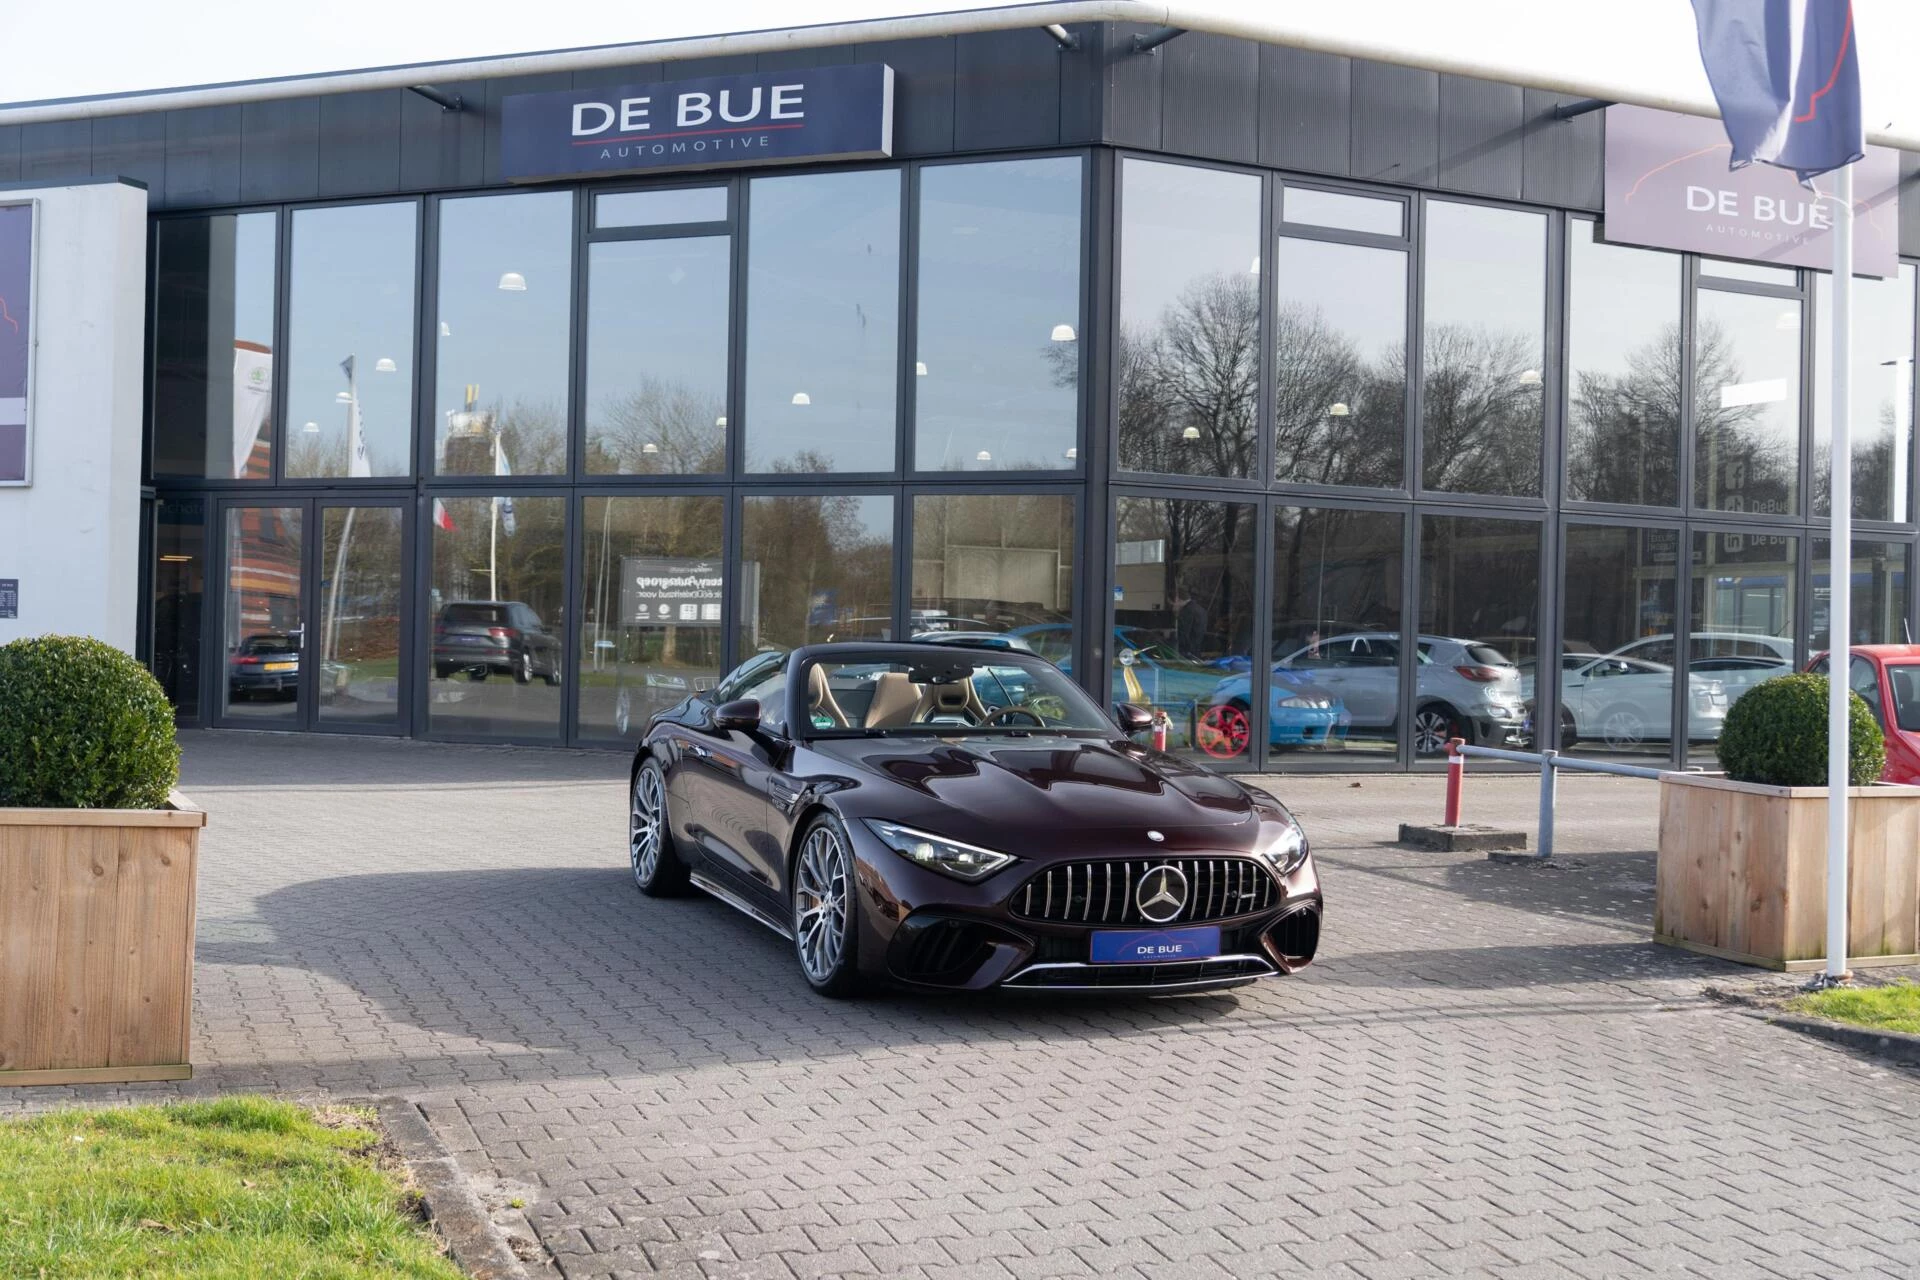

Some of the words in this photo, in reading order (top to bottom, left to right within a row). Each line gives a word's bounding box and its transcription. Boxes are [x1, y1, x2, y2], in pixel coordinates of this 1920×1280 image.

[571, 97, 651, 137] DE
[676, 83, 805, 127] BUE
[600, 136, 769, 160] AUTOMOTIVE
[1686, 185, 1739, 216] DE
[1754, 195, 1829, 230] BUE
[1705, 223, 1809, 246] AUTOMOTIVE
[1137, 946, 1155, 954] DE
[1158, 944, 1182, 954] BUE
